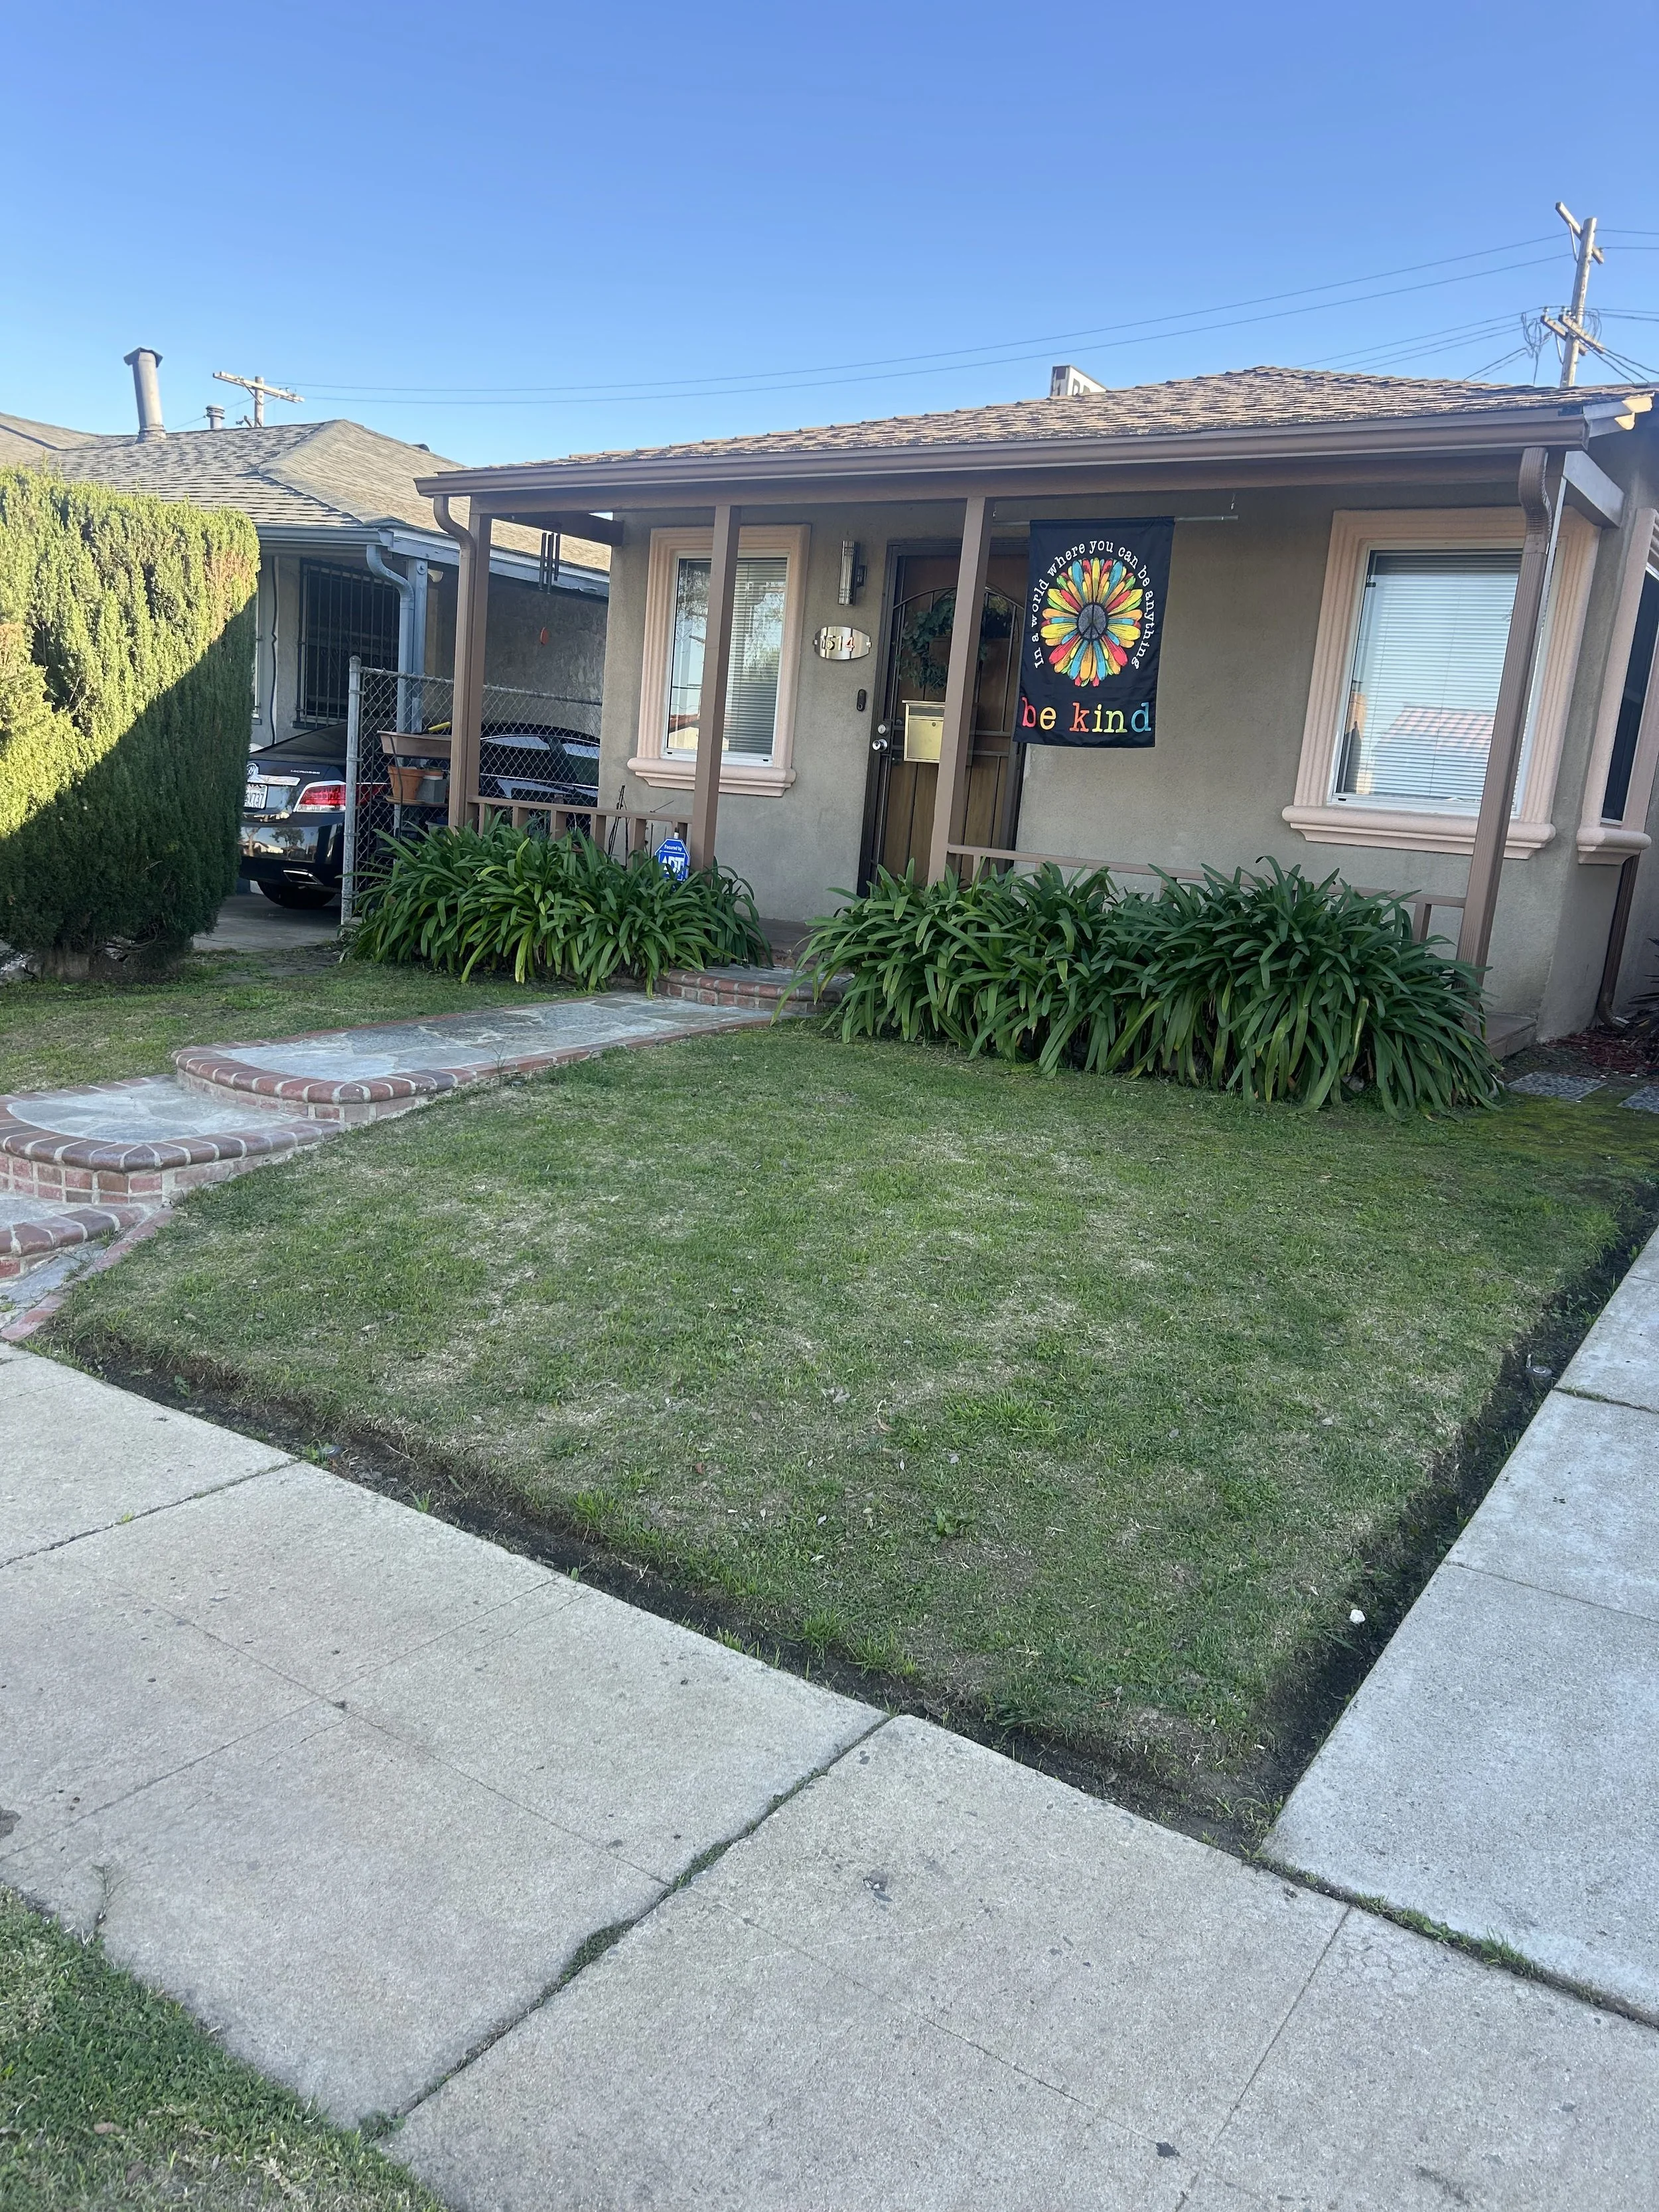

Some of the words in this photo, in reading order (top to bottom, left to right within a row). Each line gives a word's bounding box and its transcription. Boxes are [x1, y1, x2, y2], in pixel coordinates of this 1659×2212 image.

[1089, 540, 1114, 554] you
[1118, 546, 1140, 569] can
[1047, 543, 1086, 577] where
[1137, 565, 1151, 587] be
[1031, 578, 1050, 628] world
[1031, 632, 1039, 642] a
[1131, 589, 1155, 670] anything
[820, 634, 855, 652] 1514
[1034, 647, 1045, 669] In
[1021, 697, 1057, 730] be
[1069, 701, 1152, 733] kind
